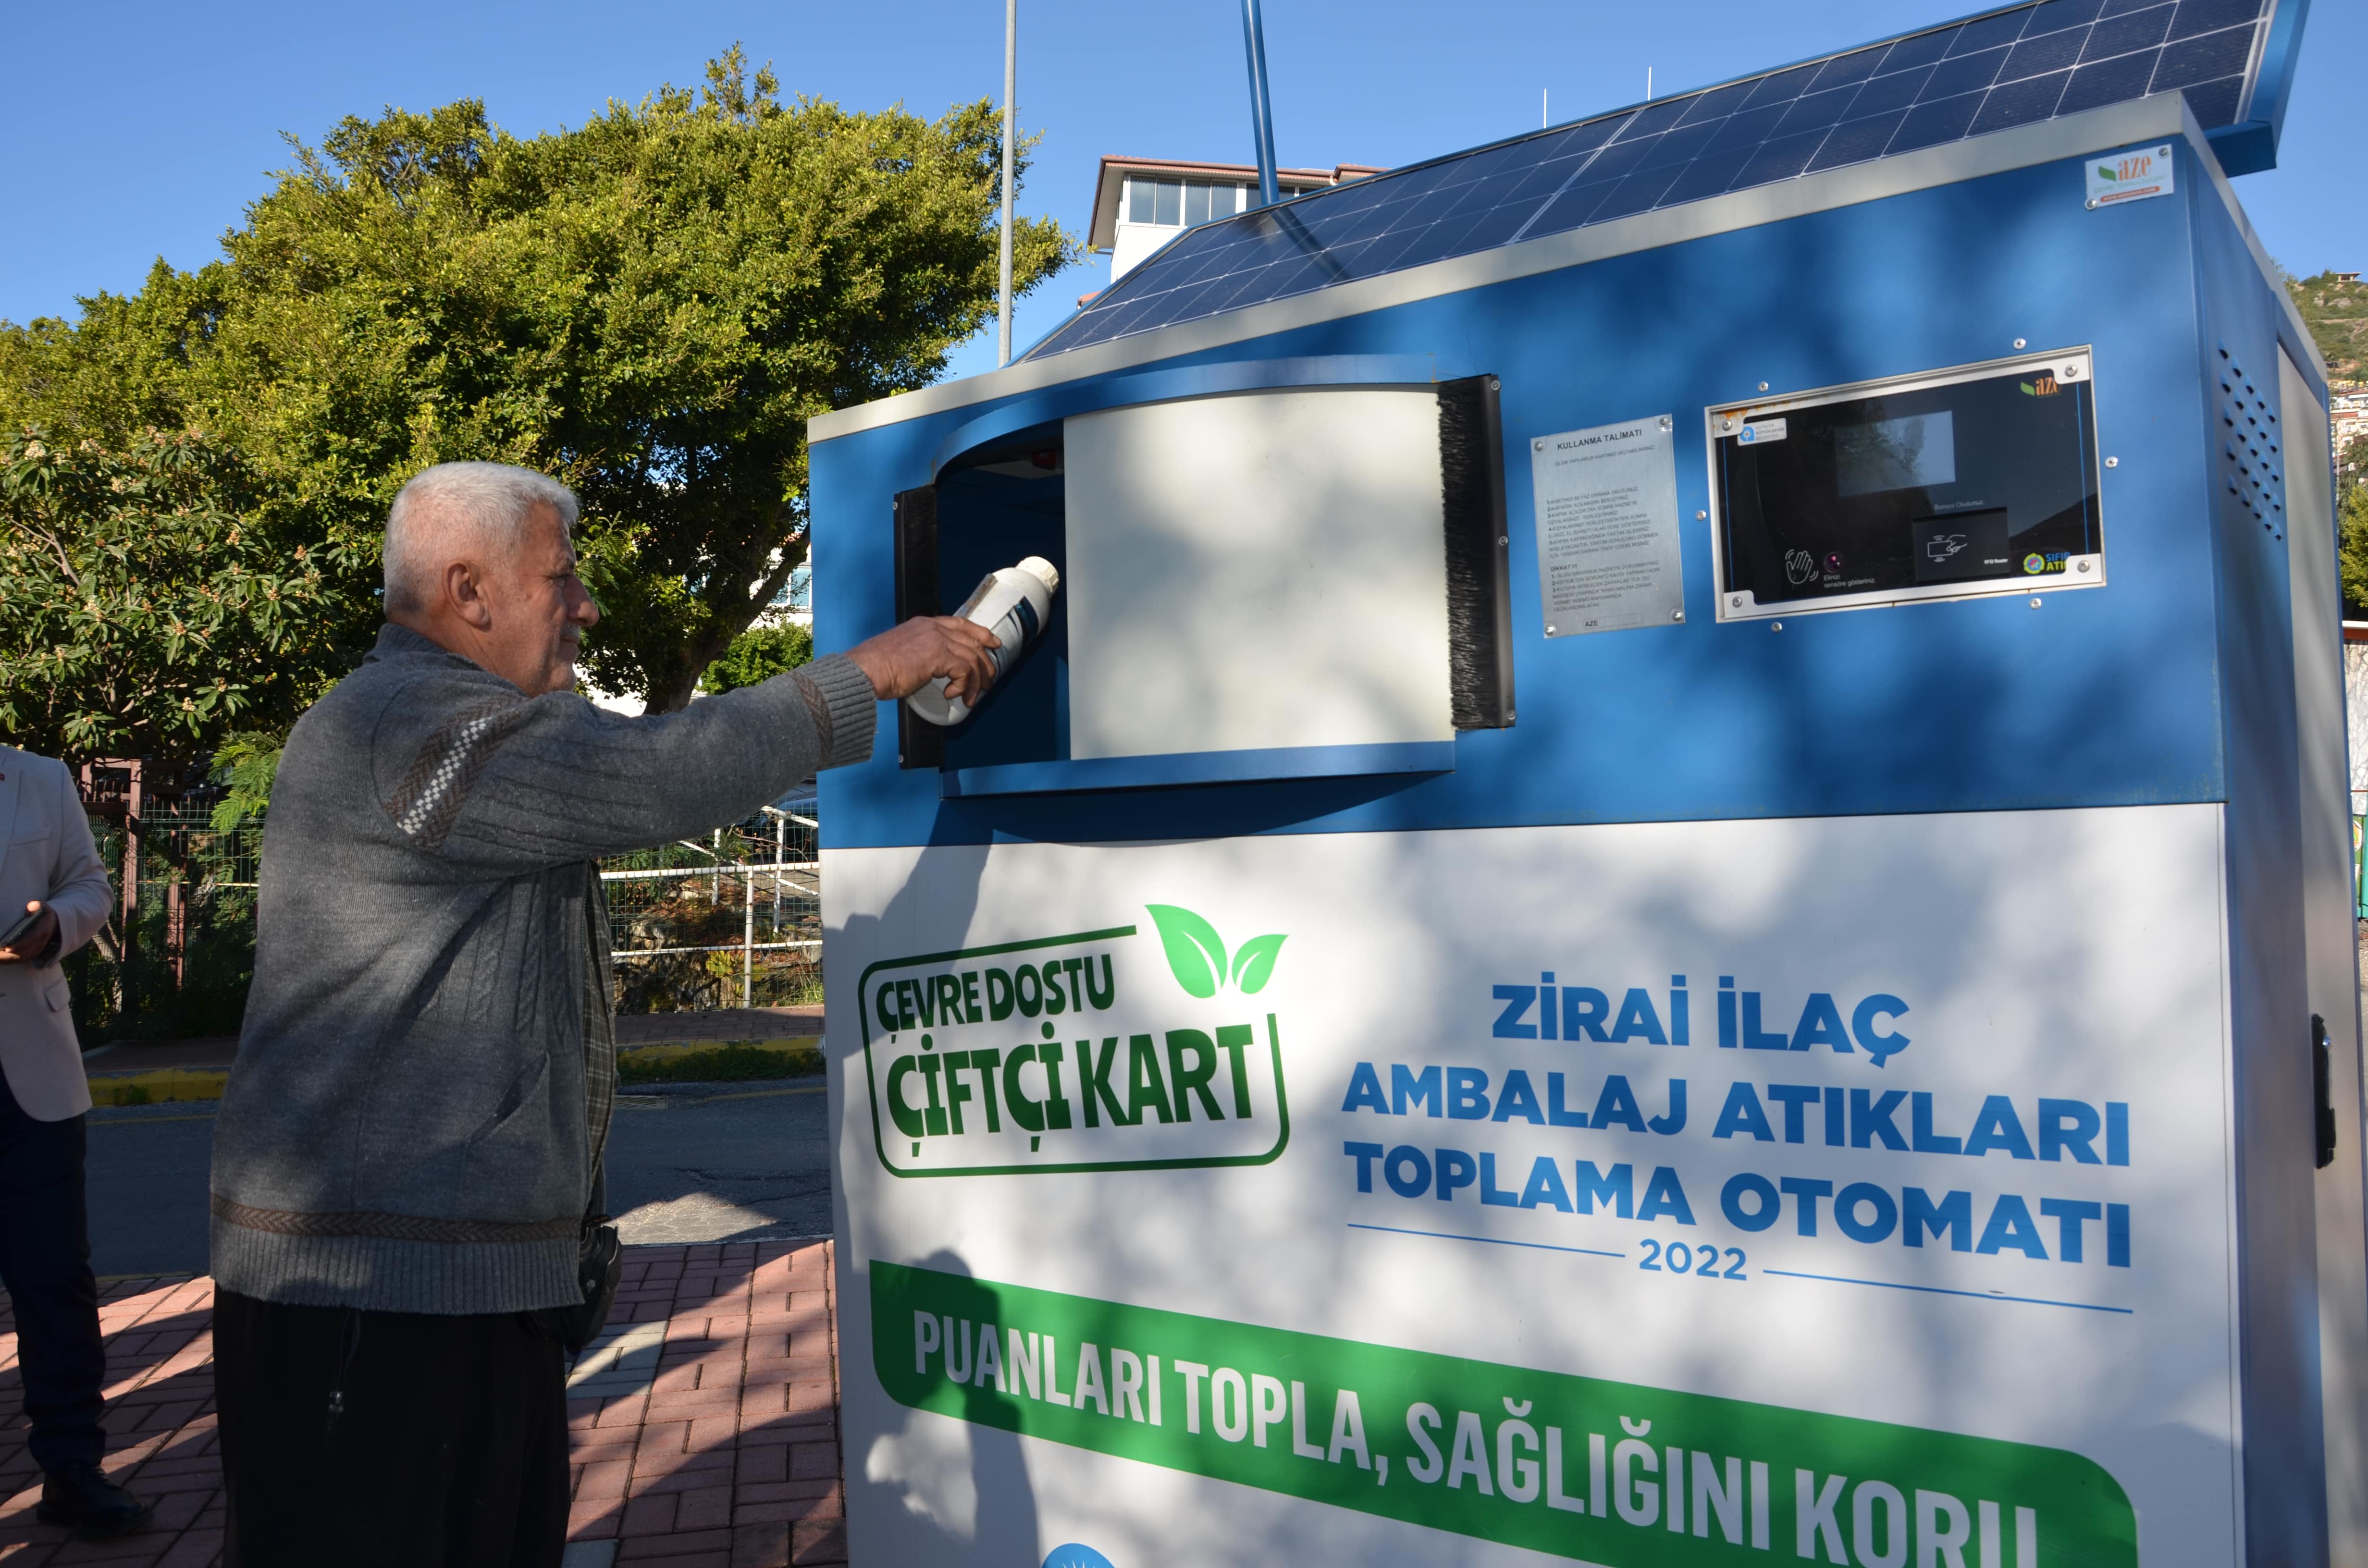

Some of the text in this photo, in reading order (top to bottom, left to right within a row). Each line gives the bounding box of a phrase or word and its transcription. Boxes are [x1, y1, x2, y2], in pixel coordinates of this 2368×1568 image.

[2118, 156, 2151, 181] aze
[1557, 429, 1642, 450] KULLANMA TALİMATI
[2046, 561, 2066, 571] ATI
[876, 954, 1115, 1043] ÇEVRE DOSTU
[1492, 971, 1911, 1069] ZİRAİ İLAÇ
[887, 1021, 1253, 1157] ÇİFTÇİ KART
[1341, 1062, 2130, 1166] AMBALAJ ATIKLARI
[1344, 1140, 2131, 1268] TOPLAMA OTOMATI
[1640, 1238, 1747, 1281] 2022
[914, 1310, 1162, 1426] PUANLARI
[1174, 1359, 1388, 1486] TOPLA,
[1406, 1396, 1770, 1551] SAĞLIĞINI
